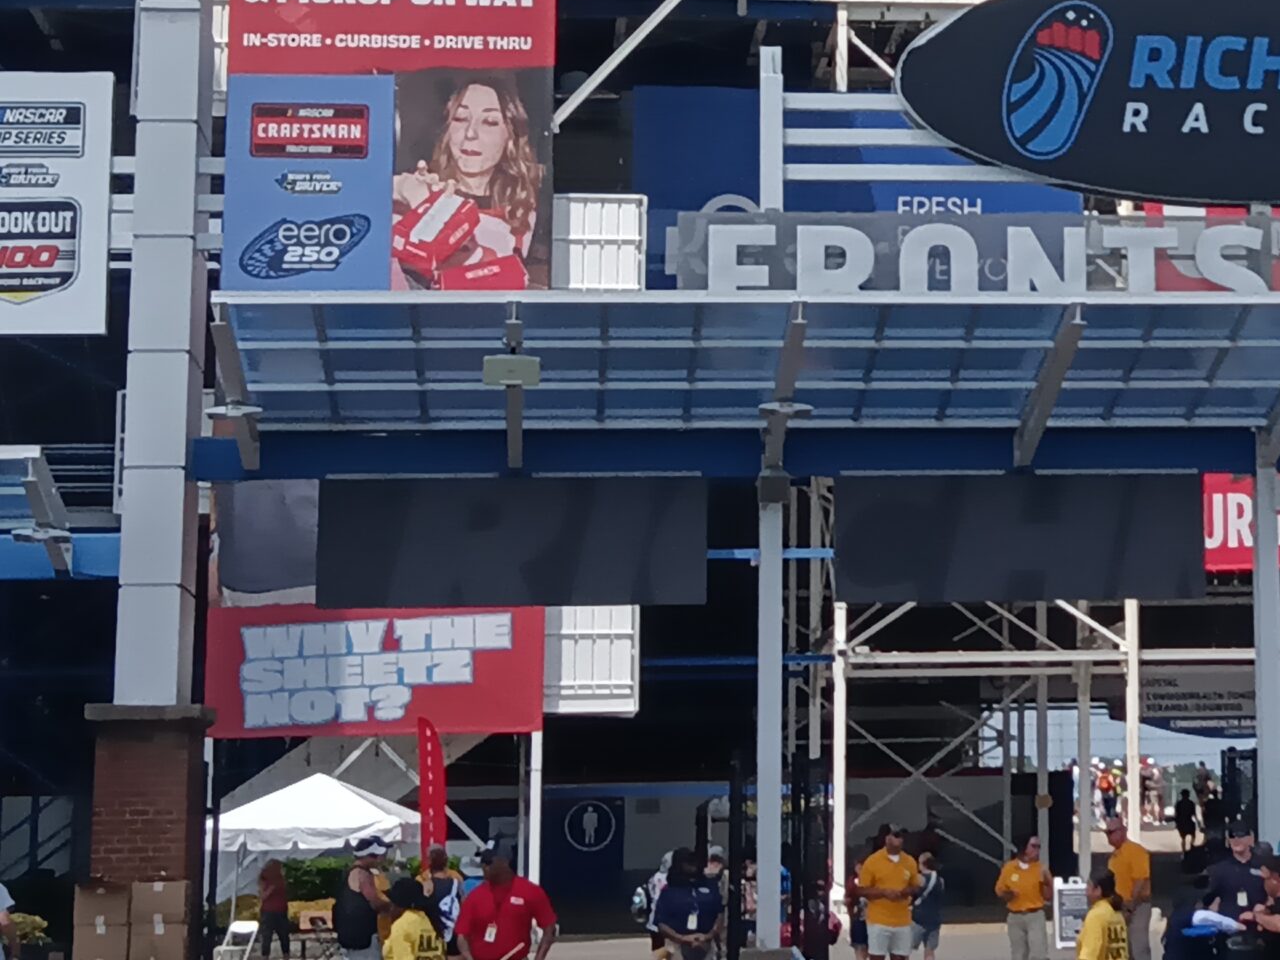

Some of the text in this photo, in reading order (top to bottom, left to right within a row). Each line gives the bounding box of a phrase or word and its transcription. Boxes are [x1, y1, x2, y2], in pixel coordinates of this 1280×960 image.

[243, 33, 322, 48] IN-STORE
[434, 36, 484, 49] DRIVE
[487, 37, 532, 50] THRU
[4, 108, 67, 123] NASCAR
[14, 131, 67, 144] SERIES
[257, 123, 361, 139] CRAFTSMAN
[37, 211, 74, 233] OUT
[278, 223, 351, 245] eero
[283, 246, 340, 262] 250
[240, 612, 512, 659] WHY THE
[240, 649, 473, 693] SHEETZ
[243, 684, 412, 729] NOT?
